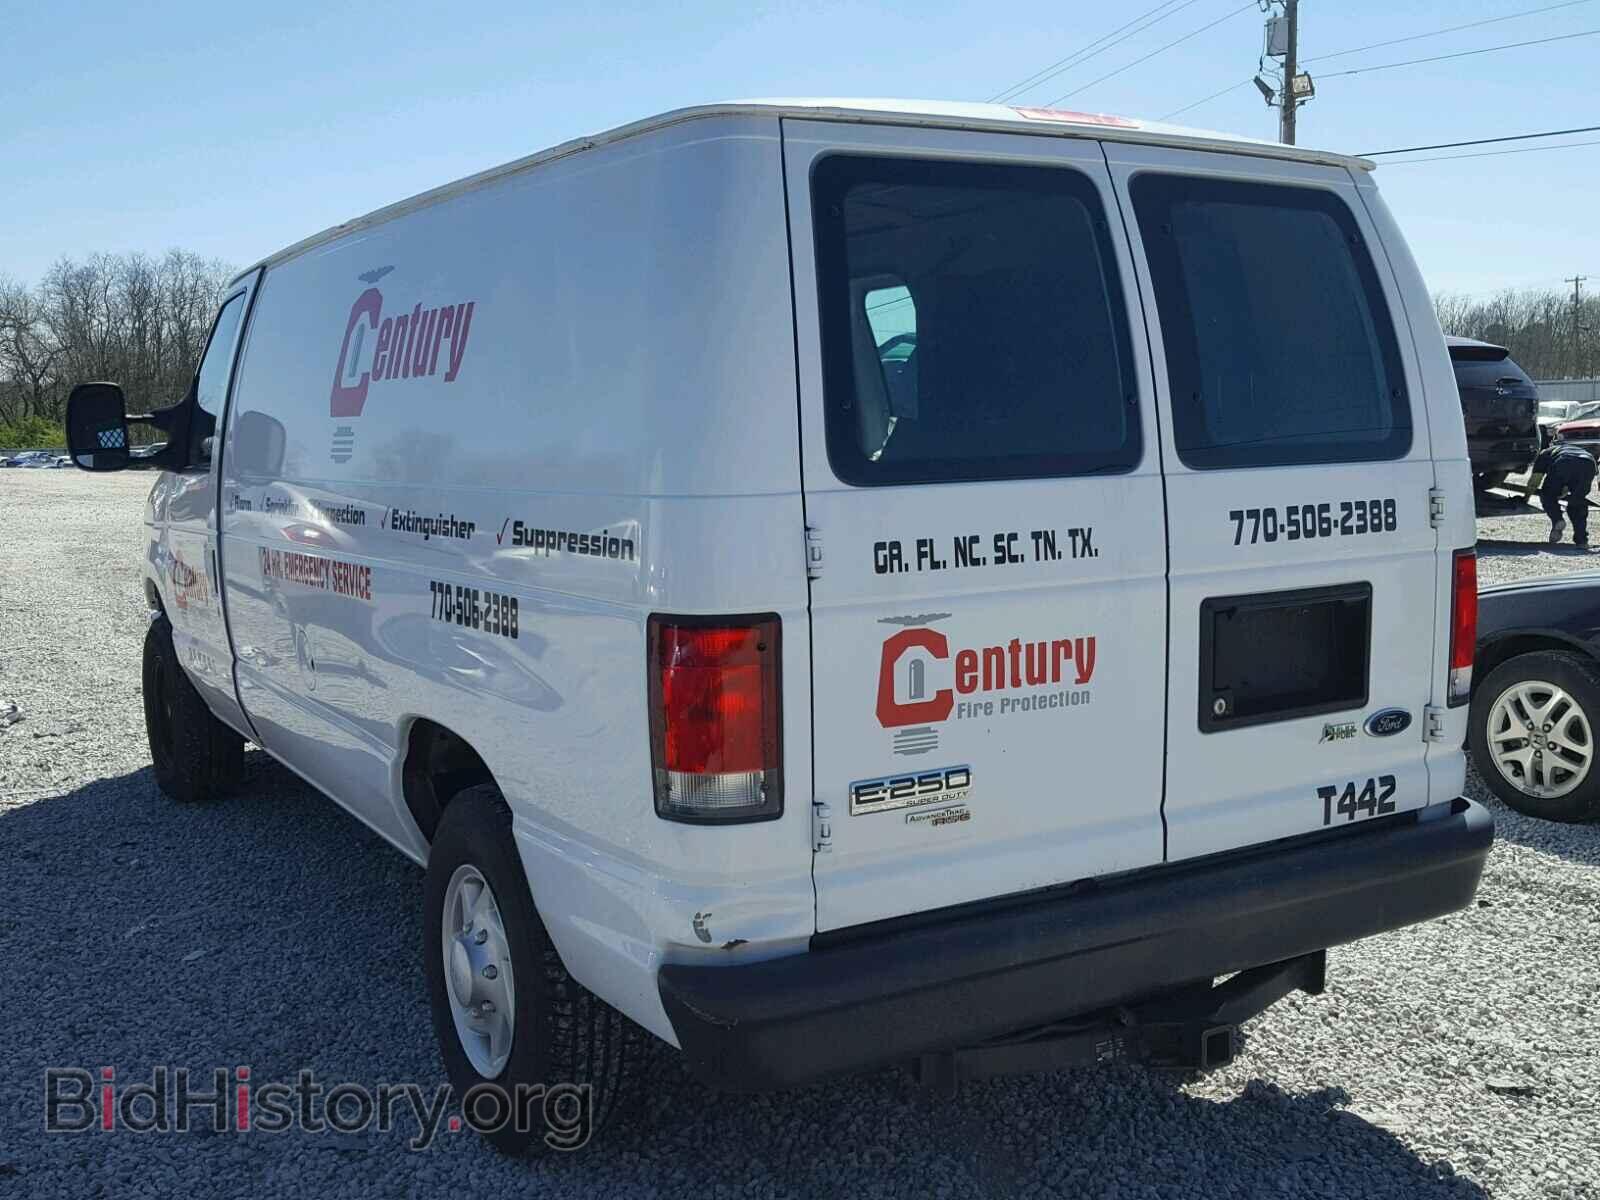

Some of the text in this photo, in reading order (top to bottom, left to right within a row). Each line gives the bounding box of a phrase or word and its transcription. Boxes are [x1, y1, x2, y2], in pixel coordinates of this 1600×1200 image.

[330, 287, 475, 417] Century
[391, 508, 476, 541] Extinguisher
[512, 520, 635, 560] Suppression
[873, 527, 1099, 574] GA. FL. NC. SC. TN. TX.
[285, 551, 330, 589] EMERGENCY
[332, 560, 371, 600] SERVICE
[876, 628, 1096, 728] Century
[957, 690, 1091, 719] Fire Protection
[854, 768, 970, 805] E-250
[1317, 775, 1396, 825] T442
